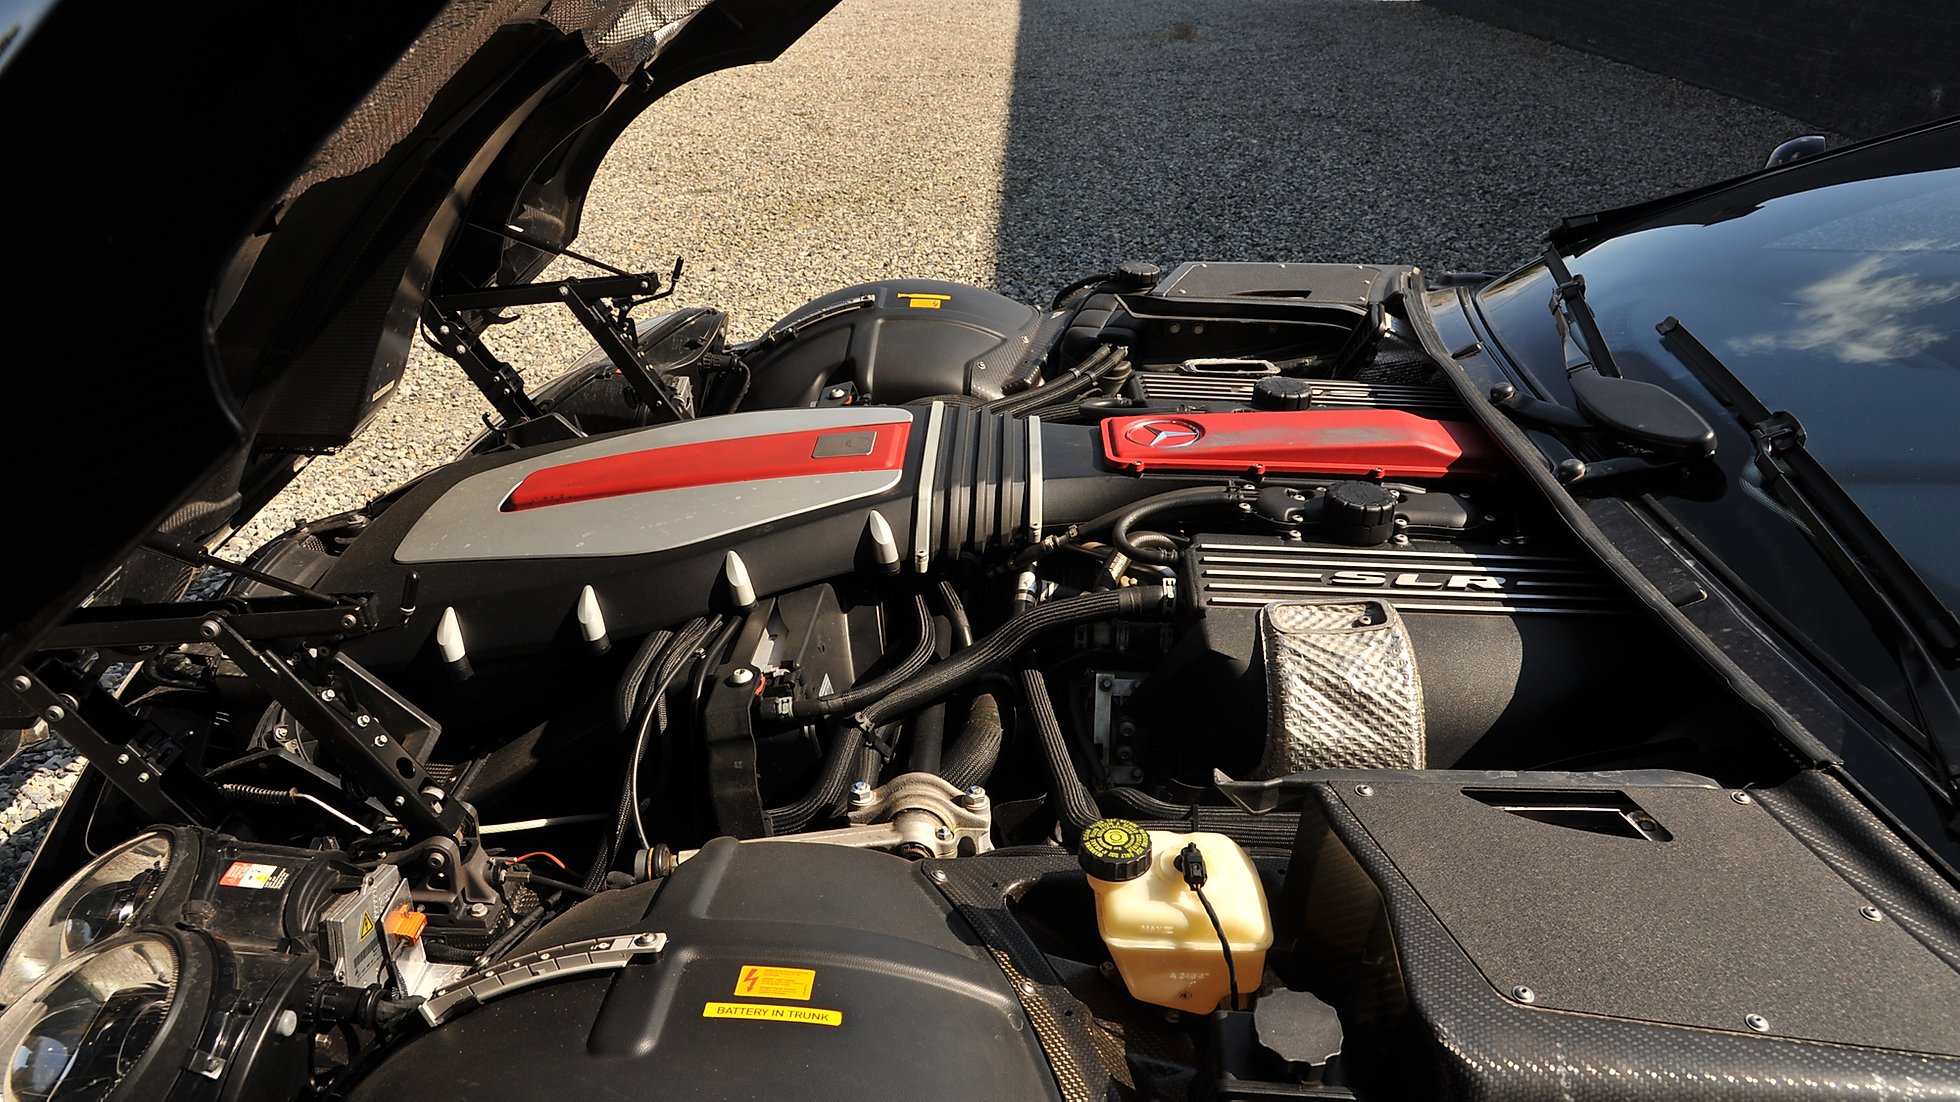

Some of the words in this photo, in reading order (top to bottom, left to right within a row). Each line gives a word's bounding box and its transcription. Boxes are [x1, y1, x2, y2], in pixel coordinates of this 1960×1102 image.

[1331, 570, 1507, 590] SLR
[716, 1006, 769, 1017] BATTERY
[771, 1009, 784, 1018] IN
[788, 1010, 830, 1022] TRUNK
